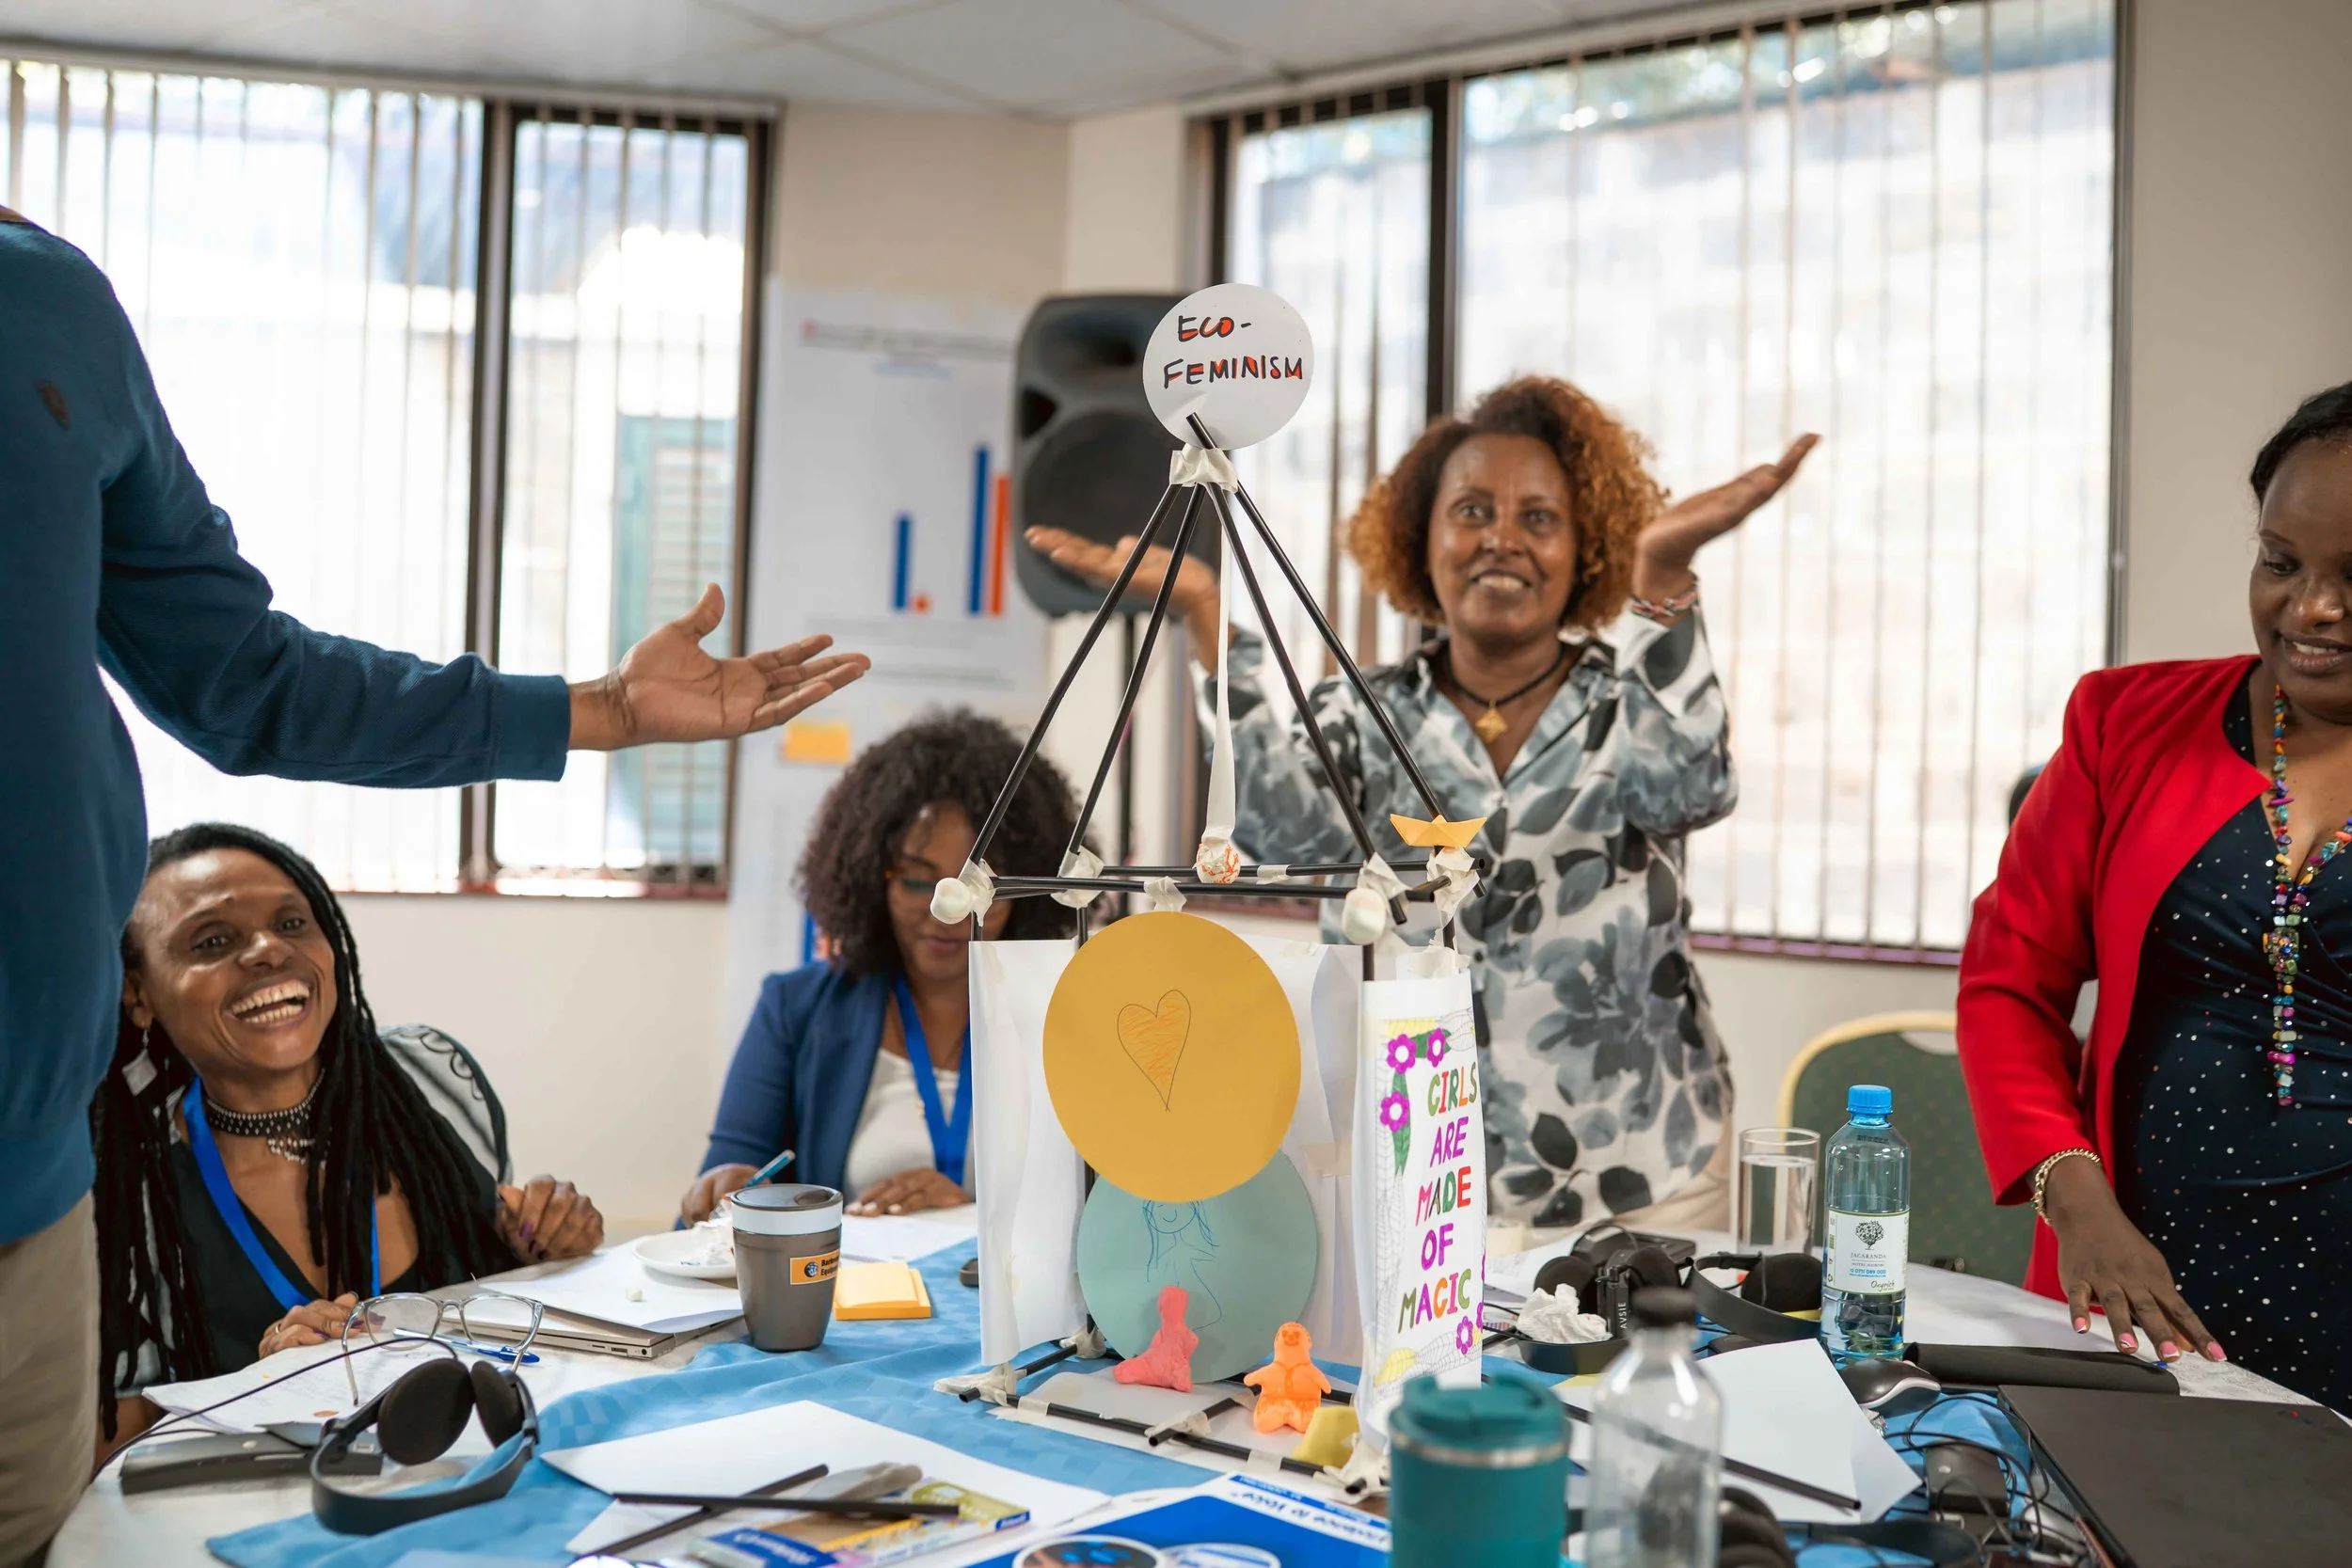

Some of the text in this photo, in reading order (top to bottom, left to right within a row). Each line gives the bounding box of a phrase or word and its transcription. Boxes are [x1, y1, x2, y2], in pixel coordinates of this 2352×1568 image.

[1178, 315, 1251, 342] ECO-
[1164, 355, 1303, 388] FEMINISM
[1427, 1062, 1477, 1117] GIRLS
[1430, 1117, 1469, 1168] ARE
[1415, 1165, 1471, 1227] MADE
[1421, 1223, 1454, 1271] OF
[1398, 1268, 1471, 1334] MAGIC
